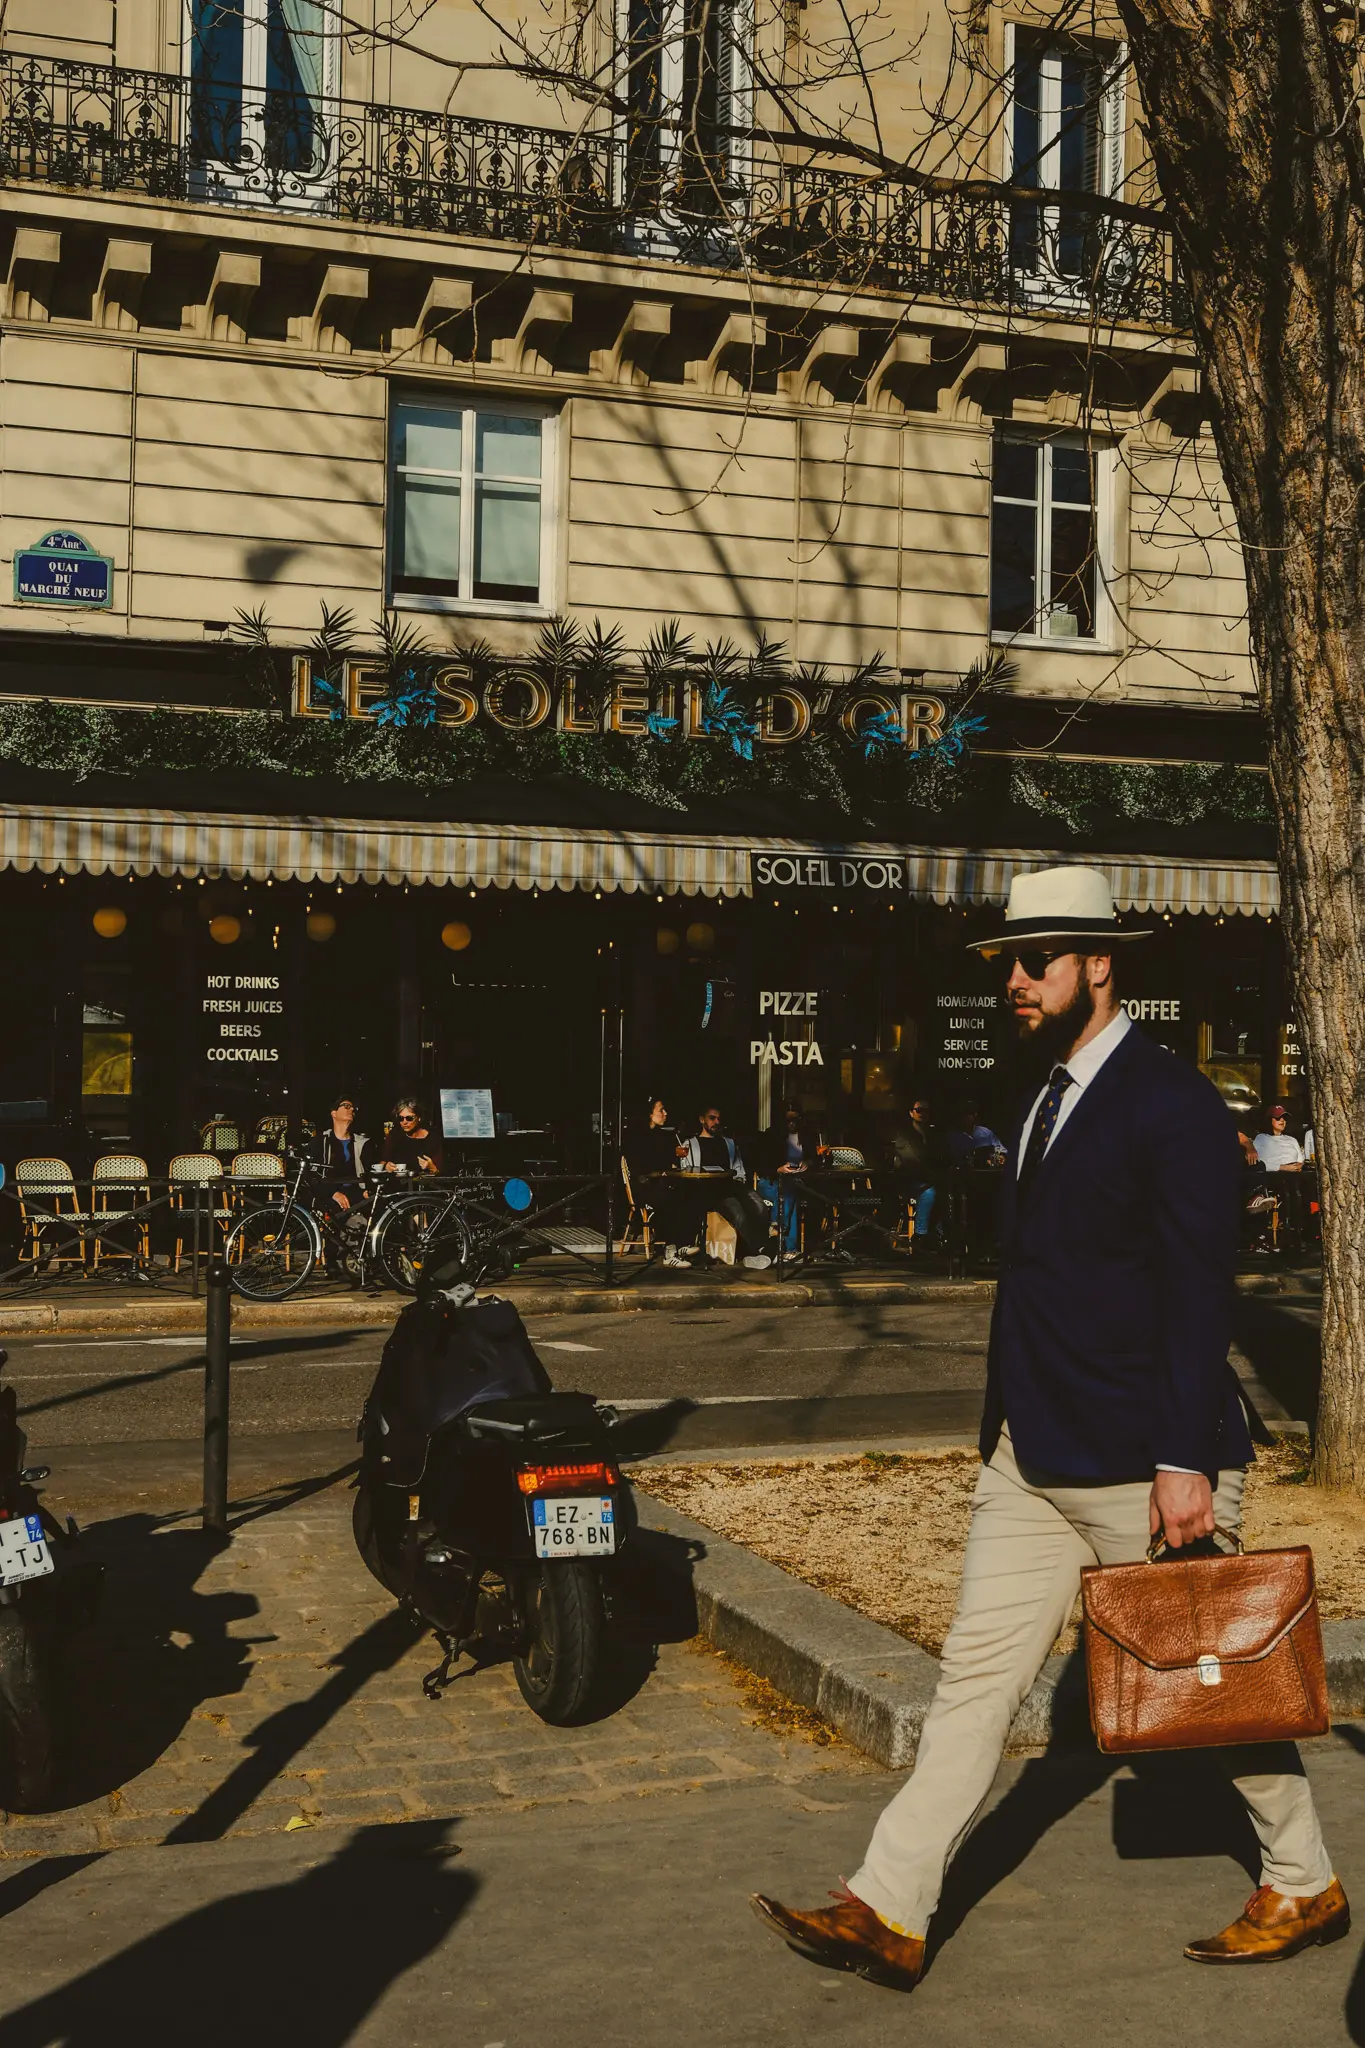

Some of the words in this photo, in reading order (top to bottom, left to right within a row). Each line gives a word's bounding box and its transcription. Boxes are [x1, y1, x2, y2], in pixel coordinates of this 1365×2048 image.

[49, 562, 79, 573] QUAI
[55, 574, 72, 584] DU
[20, 583, 70, 595] MARCHÉ
[74, 588, 107, 598] NEUF
[291, 655, 391, 721] LE
[433, 664, 725, 740] SOLEIL
[753, 687, 945, 750] D'OR
[756, 857, 835, 887] SOLEIL
[839, 861, 903, 889] D'OR
[207, 976, 231, 989] HOT
[235, 976, 280, 990] DRINKS
[203, 1000, 241, 1013] FRESH
[245, 1001, 283, 1014] JUICES
[759, 991, 818, 1016] PIZZE
[937, 995, 997, 1008] HOMEMADE
[949, 1017, 985, 1030] LUNCH
[220, 1024, 261, 1038] BEERS
[943, 1039, 988, 1051] SERVICE
[207, 1048, 279, 1062] COCKTAILS
[750, 1040, 824, 1066] PASTA
[938, 1057, 995, 1069] NON-STOP
[1281, 1064, 1298, 1076] ICE
[603, 1512, 612, 1522] 75
[29, 1529, 42, 1541] 74
